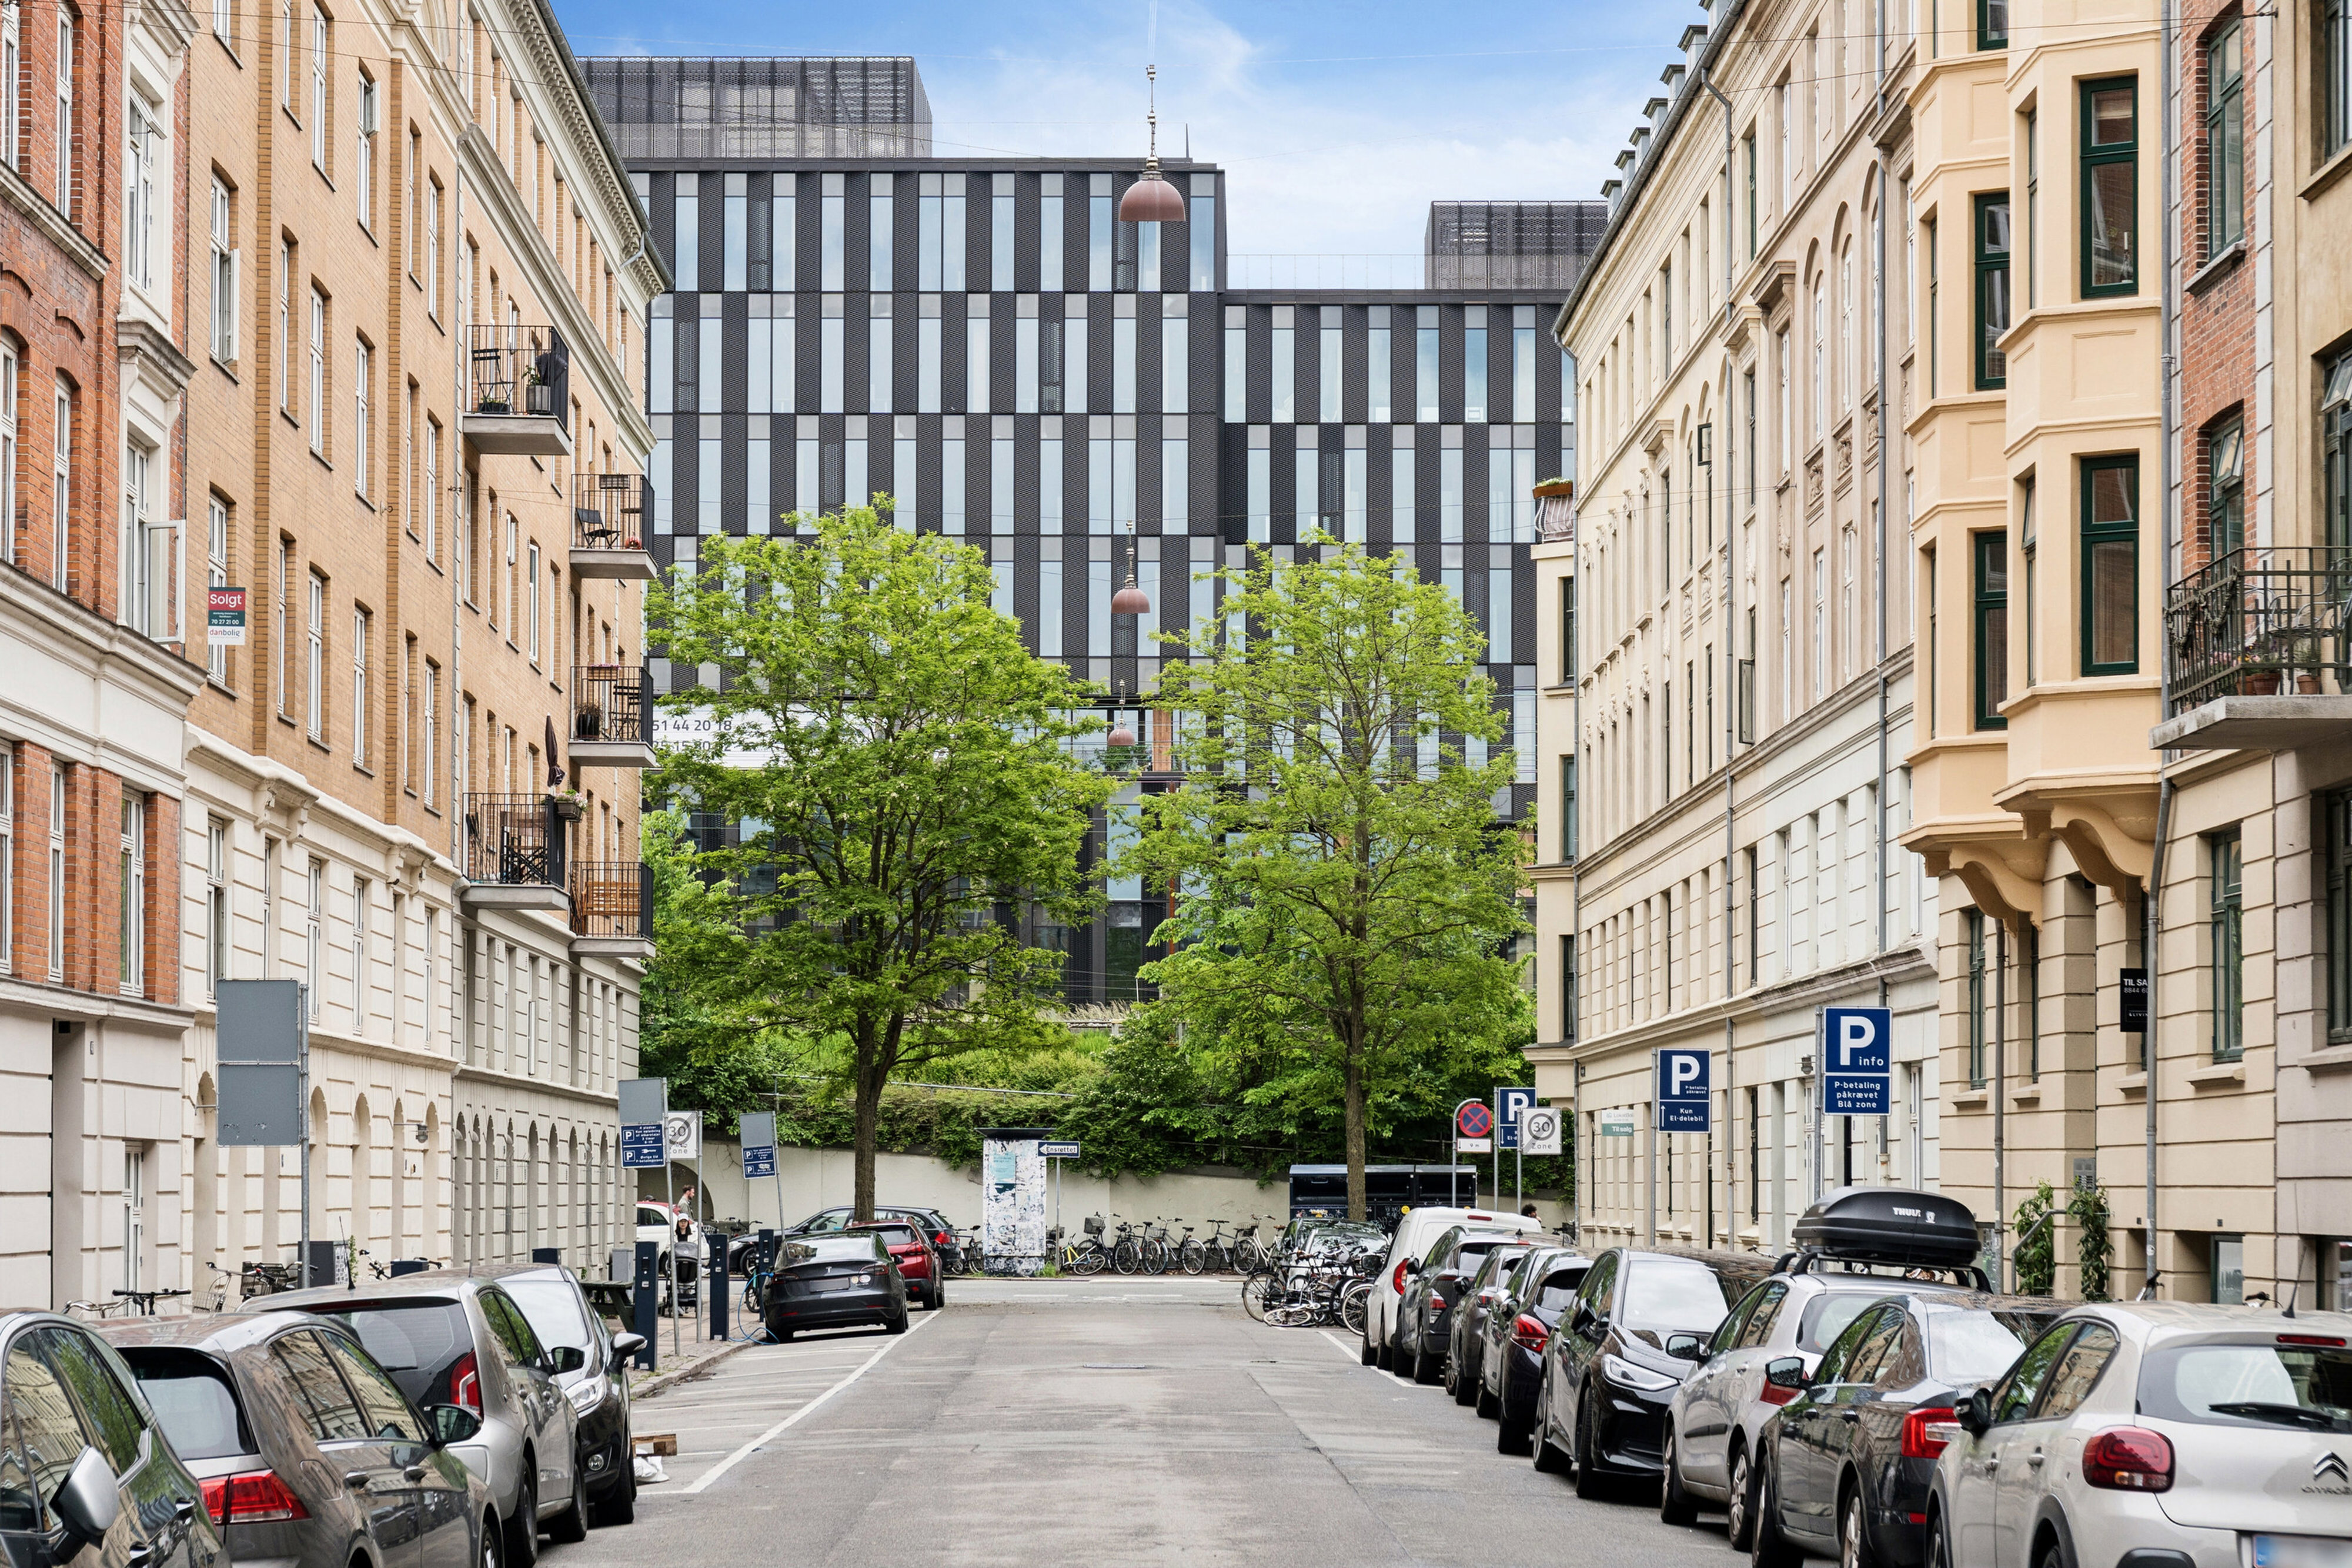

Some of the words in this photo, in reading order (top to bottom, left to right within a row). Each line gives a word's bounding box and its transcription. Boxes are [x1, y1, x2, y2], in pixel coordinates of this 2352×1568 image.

[210, 594, 242, 607] Solgt
[673, 720, 689, 731] 44
[694, 720, 711, 731] 20
[1840, 1016, 1875, 1065] P
[1859, 1057, 1884, 1066] info
[1672, 1055, 1700, 1095] P
[1835, 1081, 1880, 1090] P-betaling
[1508, 1092, 1529, 1121] P
[669, 1126, 686, 1136] 30
[1534, 1122, 1549, 1132] 30
[625, 1131, 632, 1140] P
[626, 1152, 633, 1161] P
